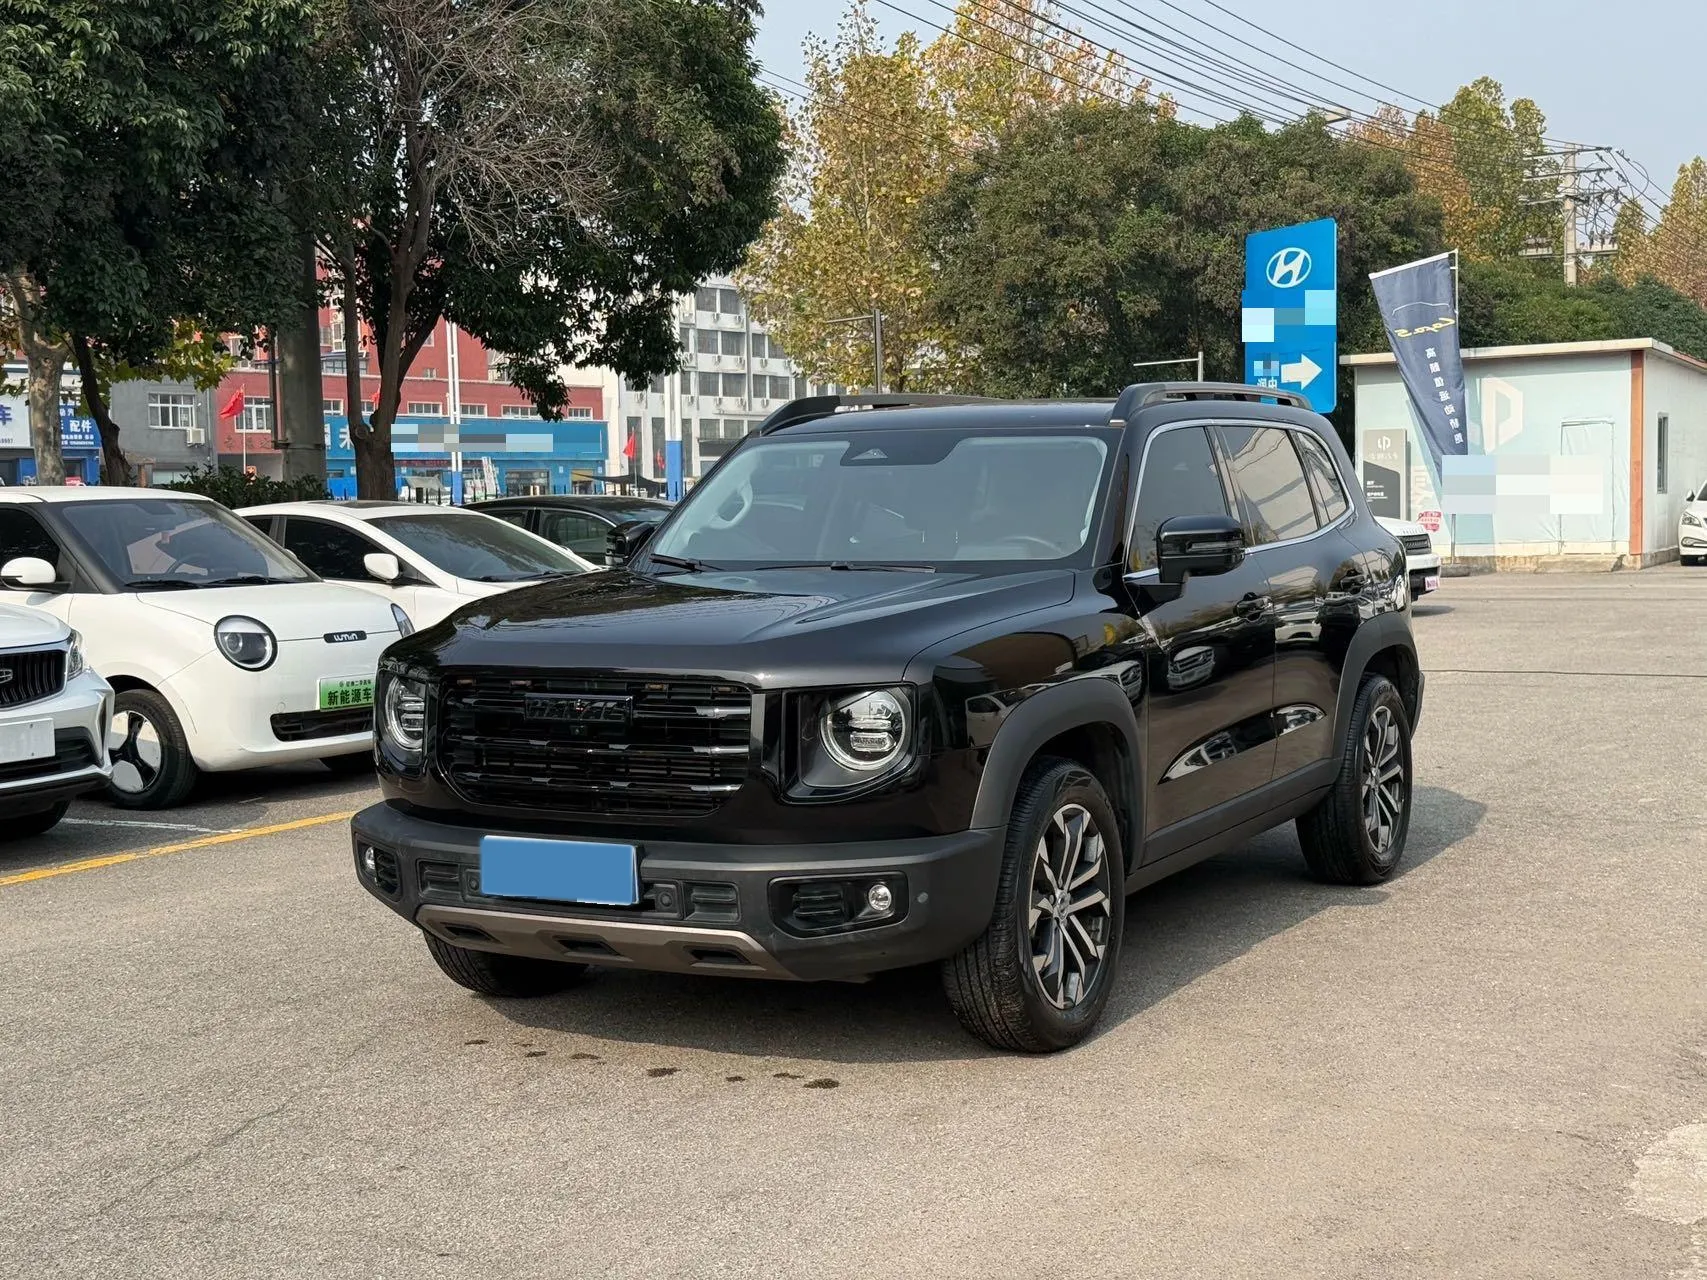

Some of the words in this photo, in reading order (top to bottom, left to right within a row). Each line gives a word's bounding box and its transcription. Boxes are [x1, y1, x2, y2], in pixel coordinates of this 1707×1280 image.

[70, 420, 92, 433] 配件
[328, 687, 372, 705] 新能源车
